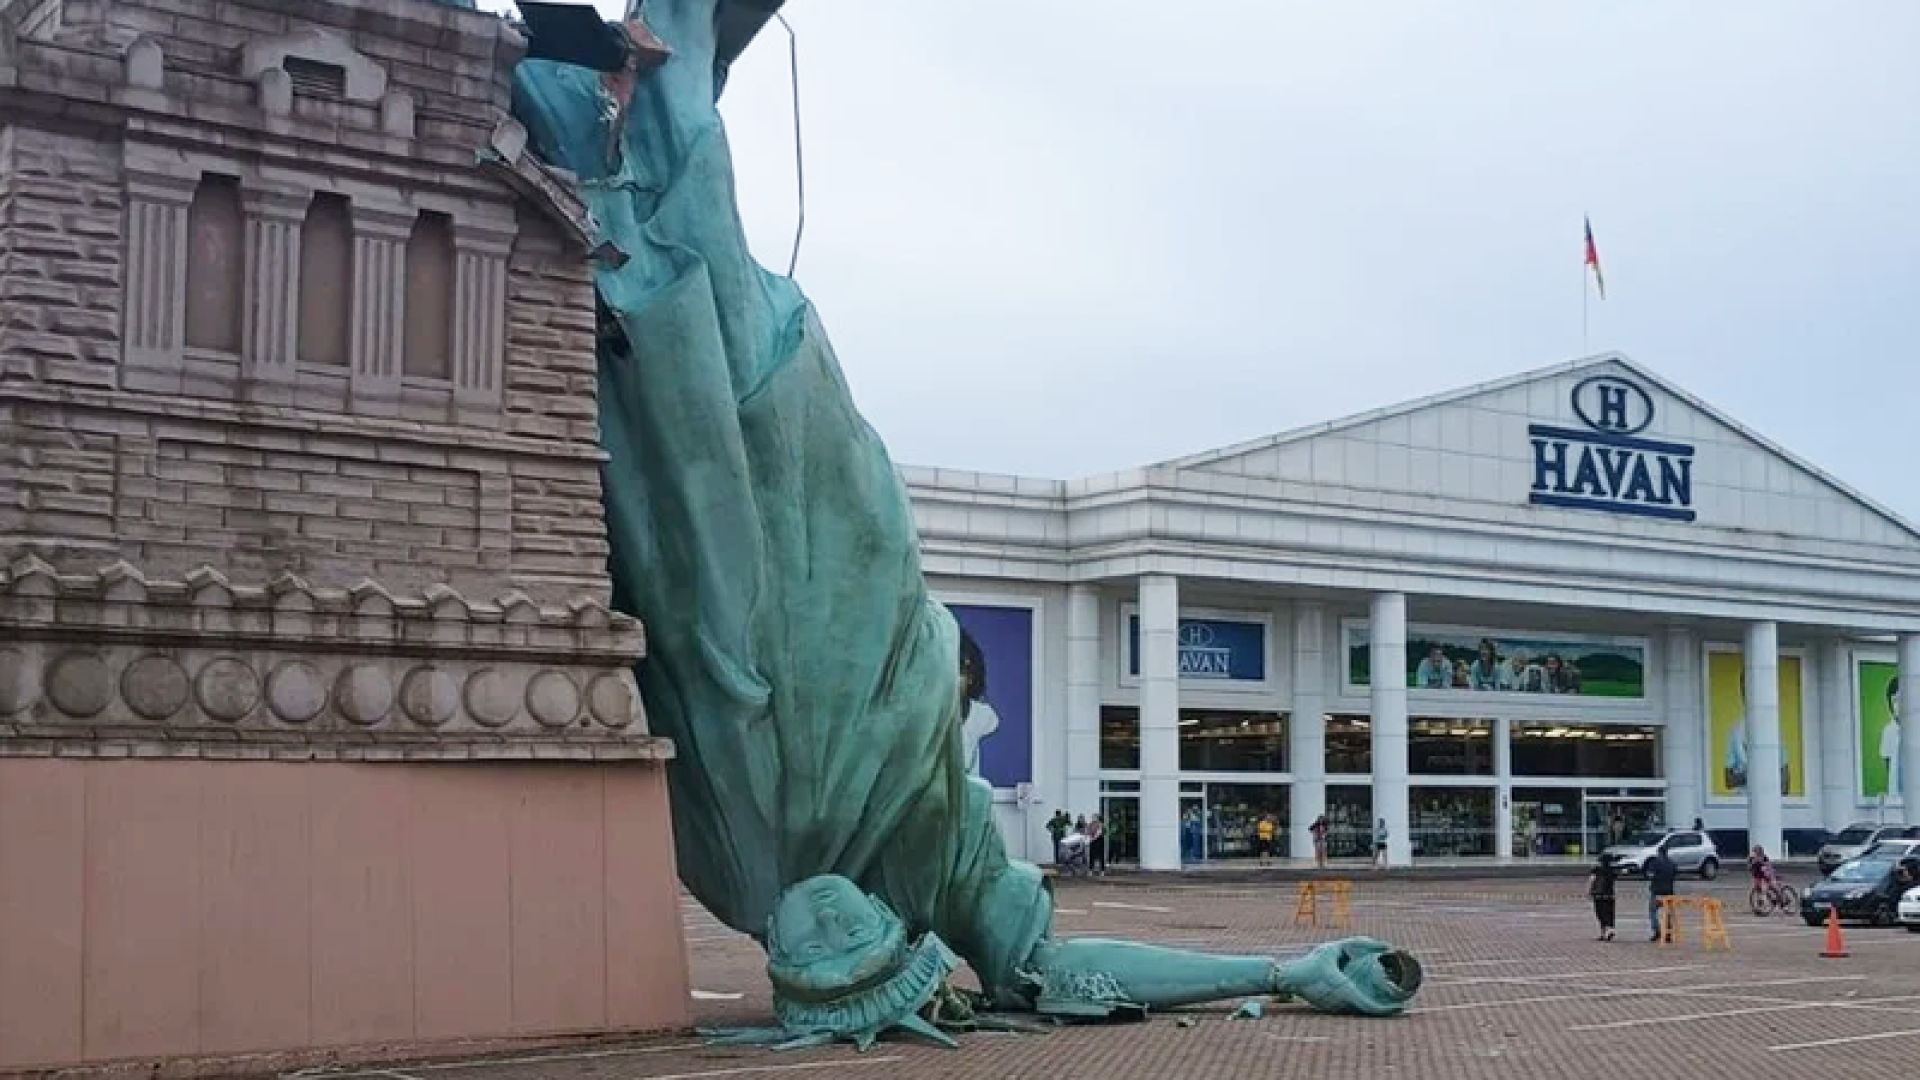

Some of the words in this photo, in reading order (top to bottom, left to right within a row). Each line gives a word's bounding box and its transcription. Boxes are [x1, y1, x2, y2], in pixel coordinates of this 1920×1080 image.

[1598, 385, 1628, 428] H
[1531, 439, 1693, 506] HAVAN
[1190, 628, 1201, 643] H
[1180, 652, 1228, 672] AVAN
